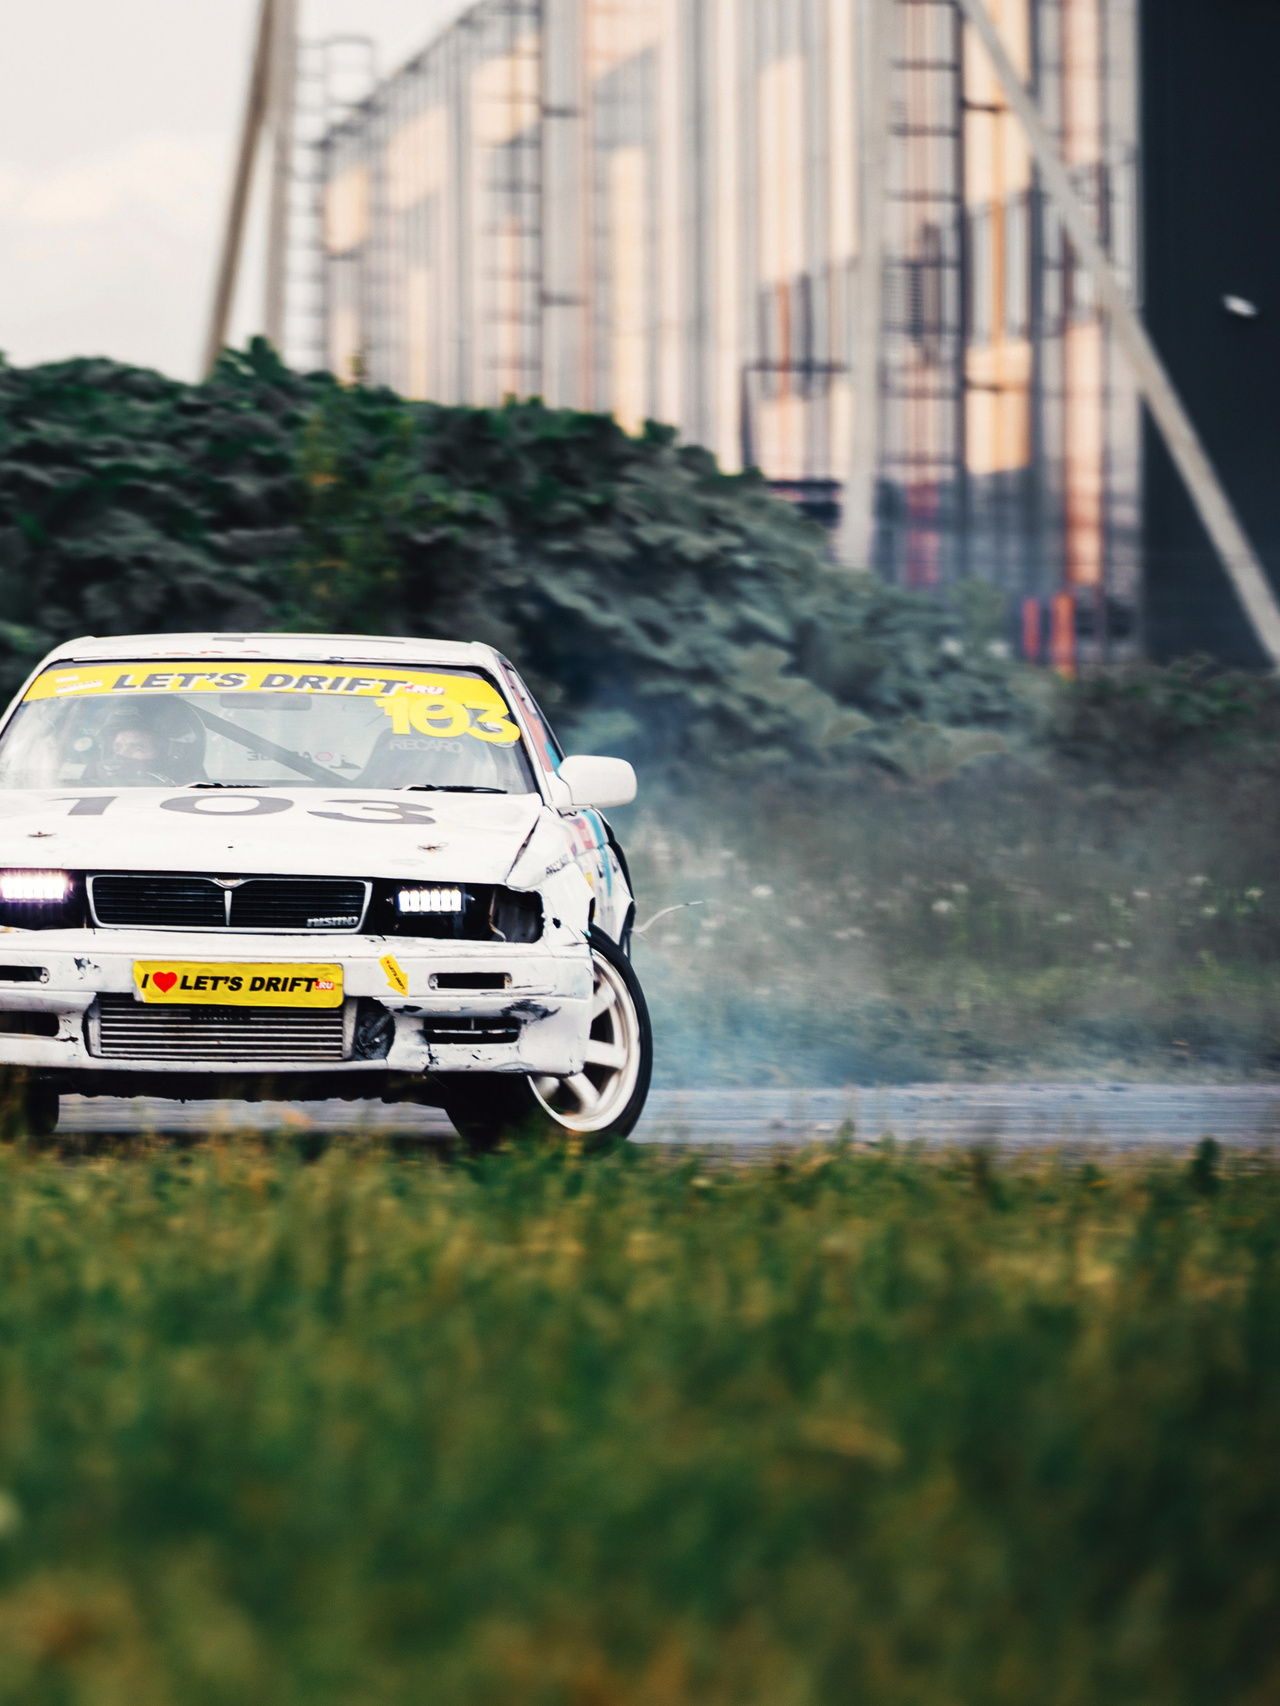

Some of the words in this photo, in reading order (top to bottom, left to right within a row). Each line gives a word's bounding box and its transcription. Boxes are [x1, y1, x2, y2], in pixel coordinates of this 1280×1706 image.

[111, 672, 249, 690] LET'S
[374, 695, 521, 743] 103
[389, 738, 464, 754] RECARO
[52, 794, 437, 825] 103
[141, 973, 149, 989] I
[179, 975, 243, 992] LET'S
